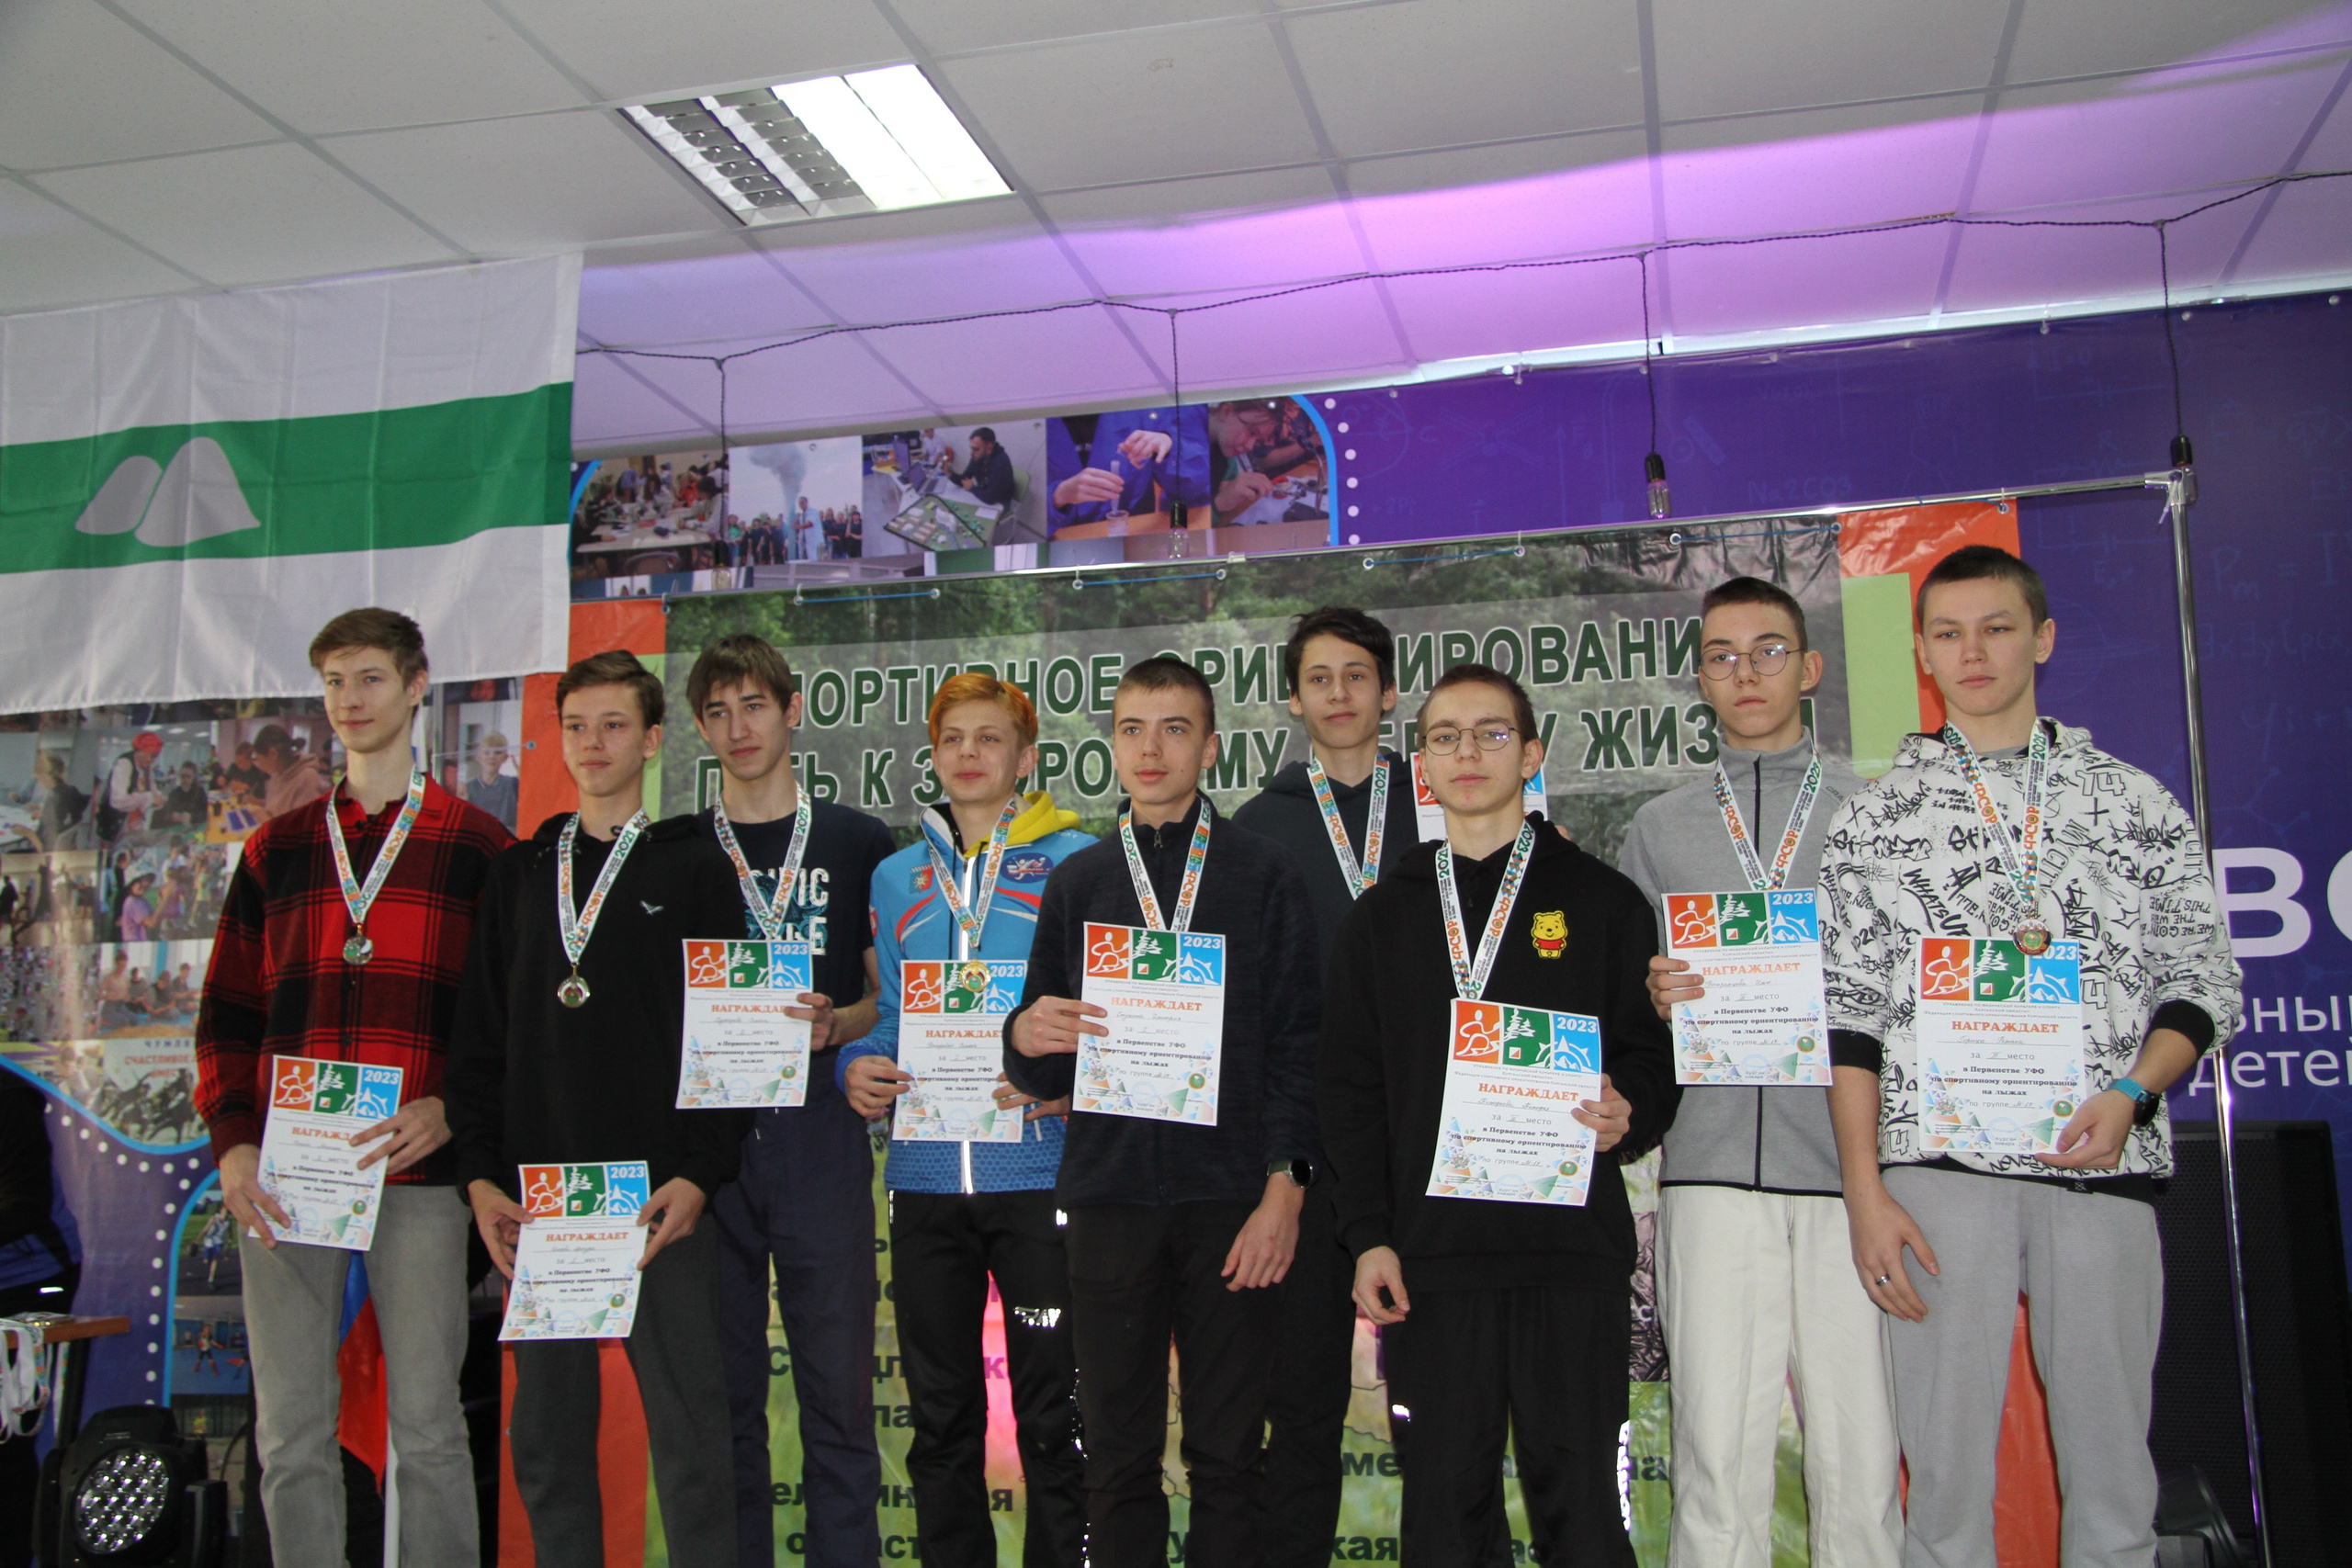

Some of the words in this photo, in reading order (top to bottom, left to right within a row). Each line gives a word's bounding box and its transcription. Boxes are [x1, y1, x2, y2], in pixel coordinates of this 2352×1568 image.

[791, 653, 1123, 728] ОРТИНОЕ
[695, 751, 841, 814] ПЬ
[861, 749, 896, 808] К
[1772, 893, 1814, 906] 2023
[774, 944, 808, 955] 2023
[1183, 936, 1222, 950] 2023
[990, 964, 1024, 978] 2023
[1702, 963, 1801, 976] НАГРАЖДАЕТ
[711, 1004, 786, 1014] НАГРАЖДАЕ
[1111, 997, 1203, 1011] НАГРАЖДАЕТ
[1556, 1017, 1597, 1033] 2023
[1951, 1021, 2059, 1033] НАГРАЖДАЕТ
[364, 1070, 400, 1085] 2023
[2188, 1045, 2352, 1096] дете
[1478, 1083, 1579, 1101] НАГРАЖДАЕТ
[291, 1126, 352, 1141] НАГРАЖД
[610, 1166, 645, 1179] 2023
[546, 1232, 629, 1242] НАГРАЖДАЕТ
